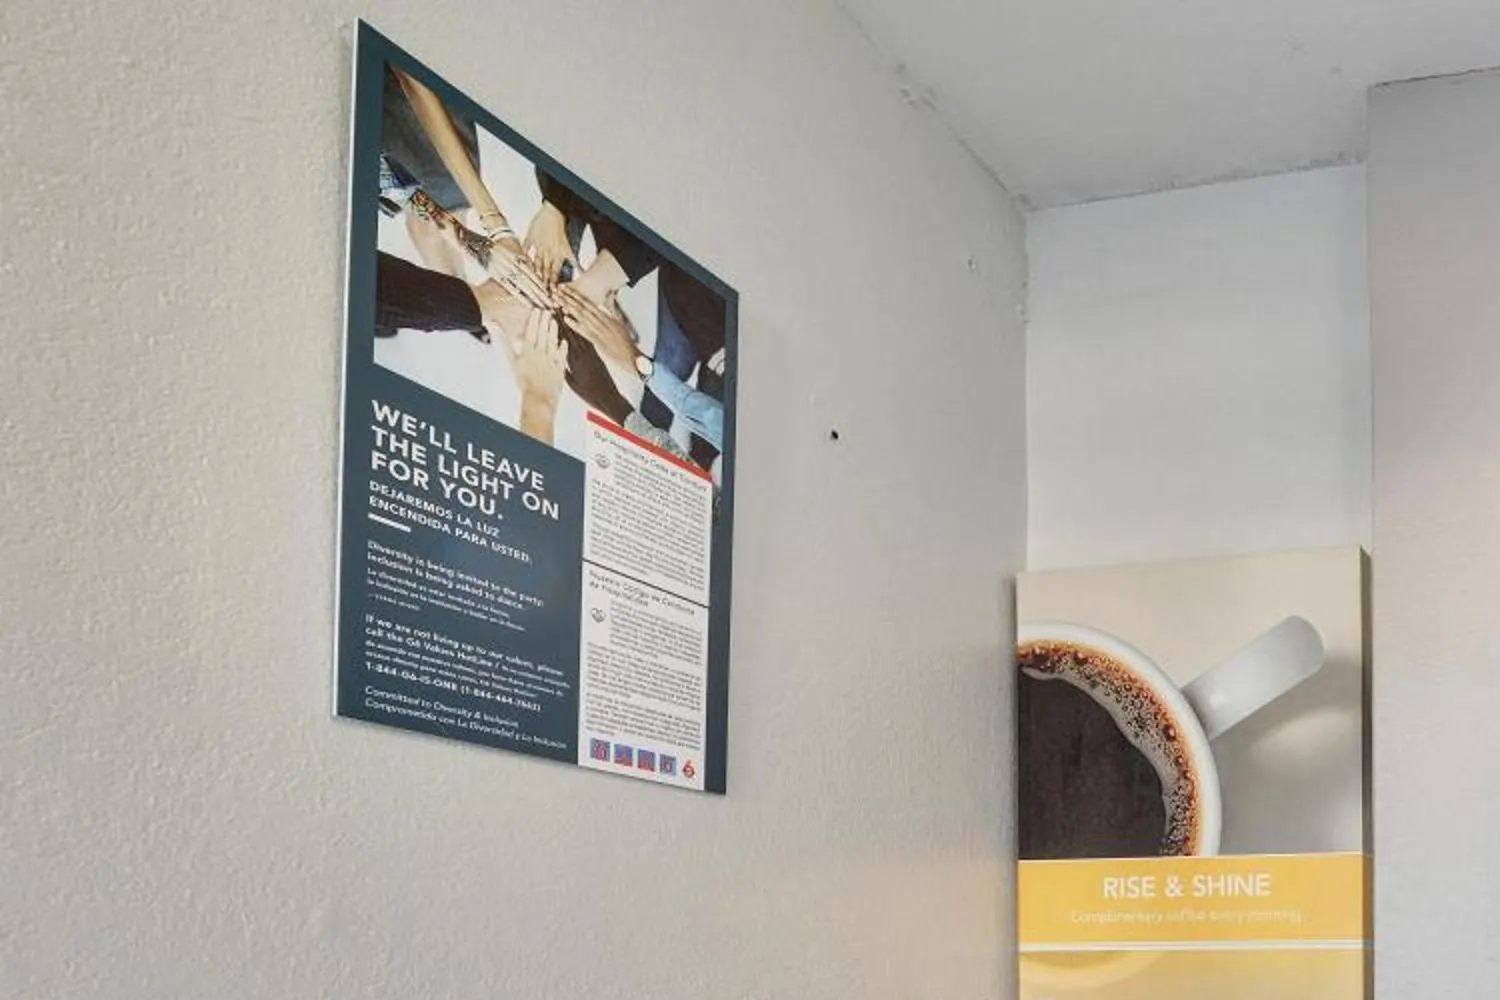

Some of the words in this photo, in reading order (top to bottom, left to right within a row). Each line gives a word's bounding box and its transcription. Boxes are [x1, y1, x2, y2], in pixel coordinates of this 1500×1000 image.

[370, 398, 457, 455] WE'LL
[466, 441, 544, 492] LEAVE
[370, 424, 427, 467] THE
[437, 452, 514, 502] LIGHT
[521, 488, 559, 521] ON
[368, 478, 453, 521] DEJAREMOS
[457, 512, 472, 528] LA
[477, 520, 500, 539] LUZ
[371, 449, 429, 491] FOR
[438, 477, 503, 520] YOU.
[368, 494, 451, 535] ENCENDIDA
[455, 526, 486, 548] PARA
[1102, 875, 1157, 899] RISE
[1164, 875, 1184, 899] &
[1192, 872, 1272, 898] SHINE
[1070, 908, 1163, 926] Complimentary
